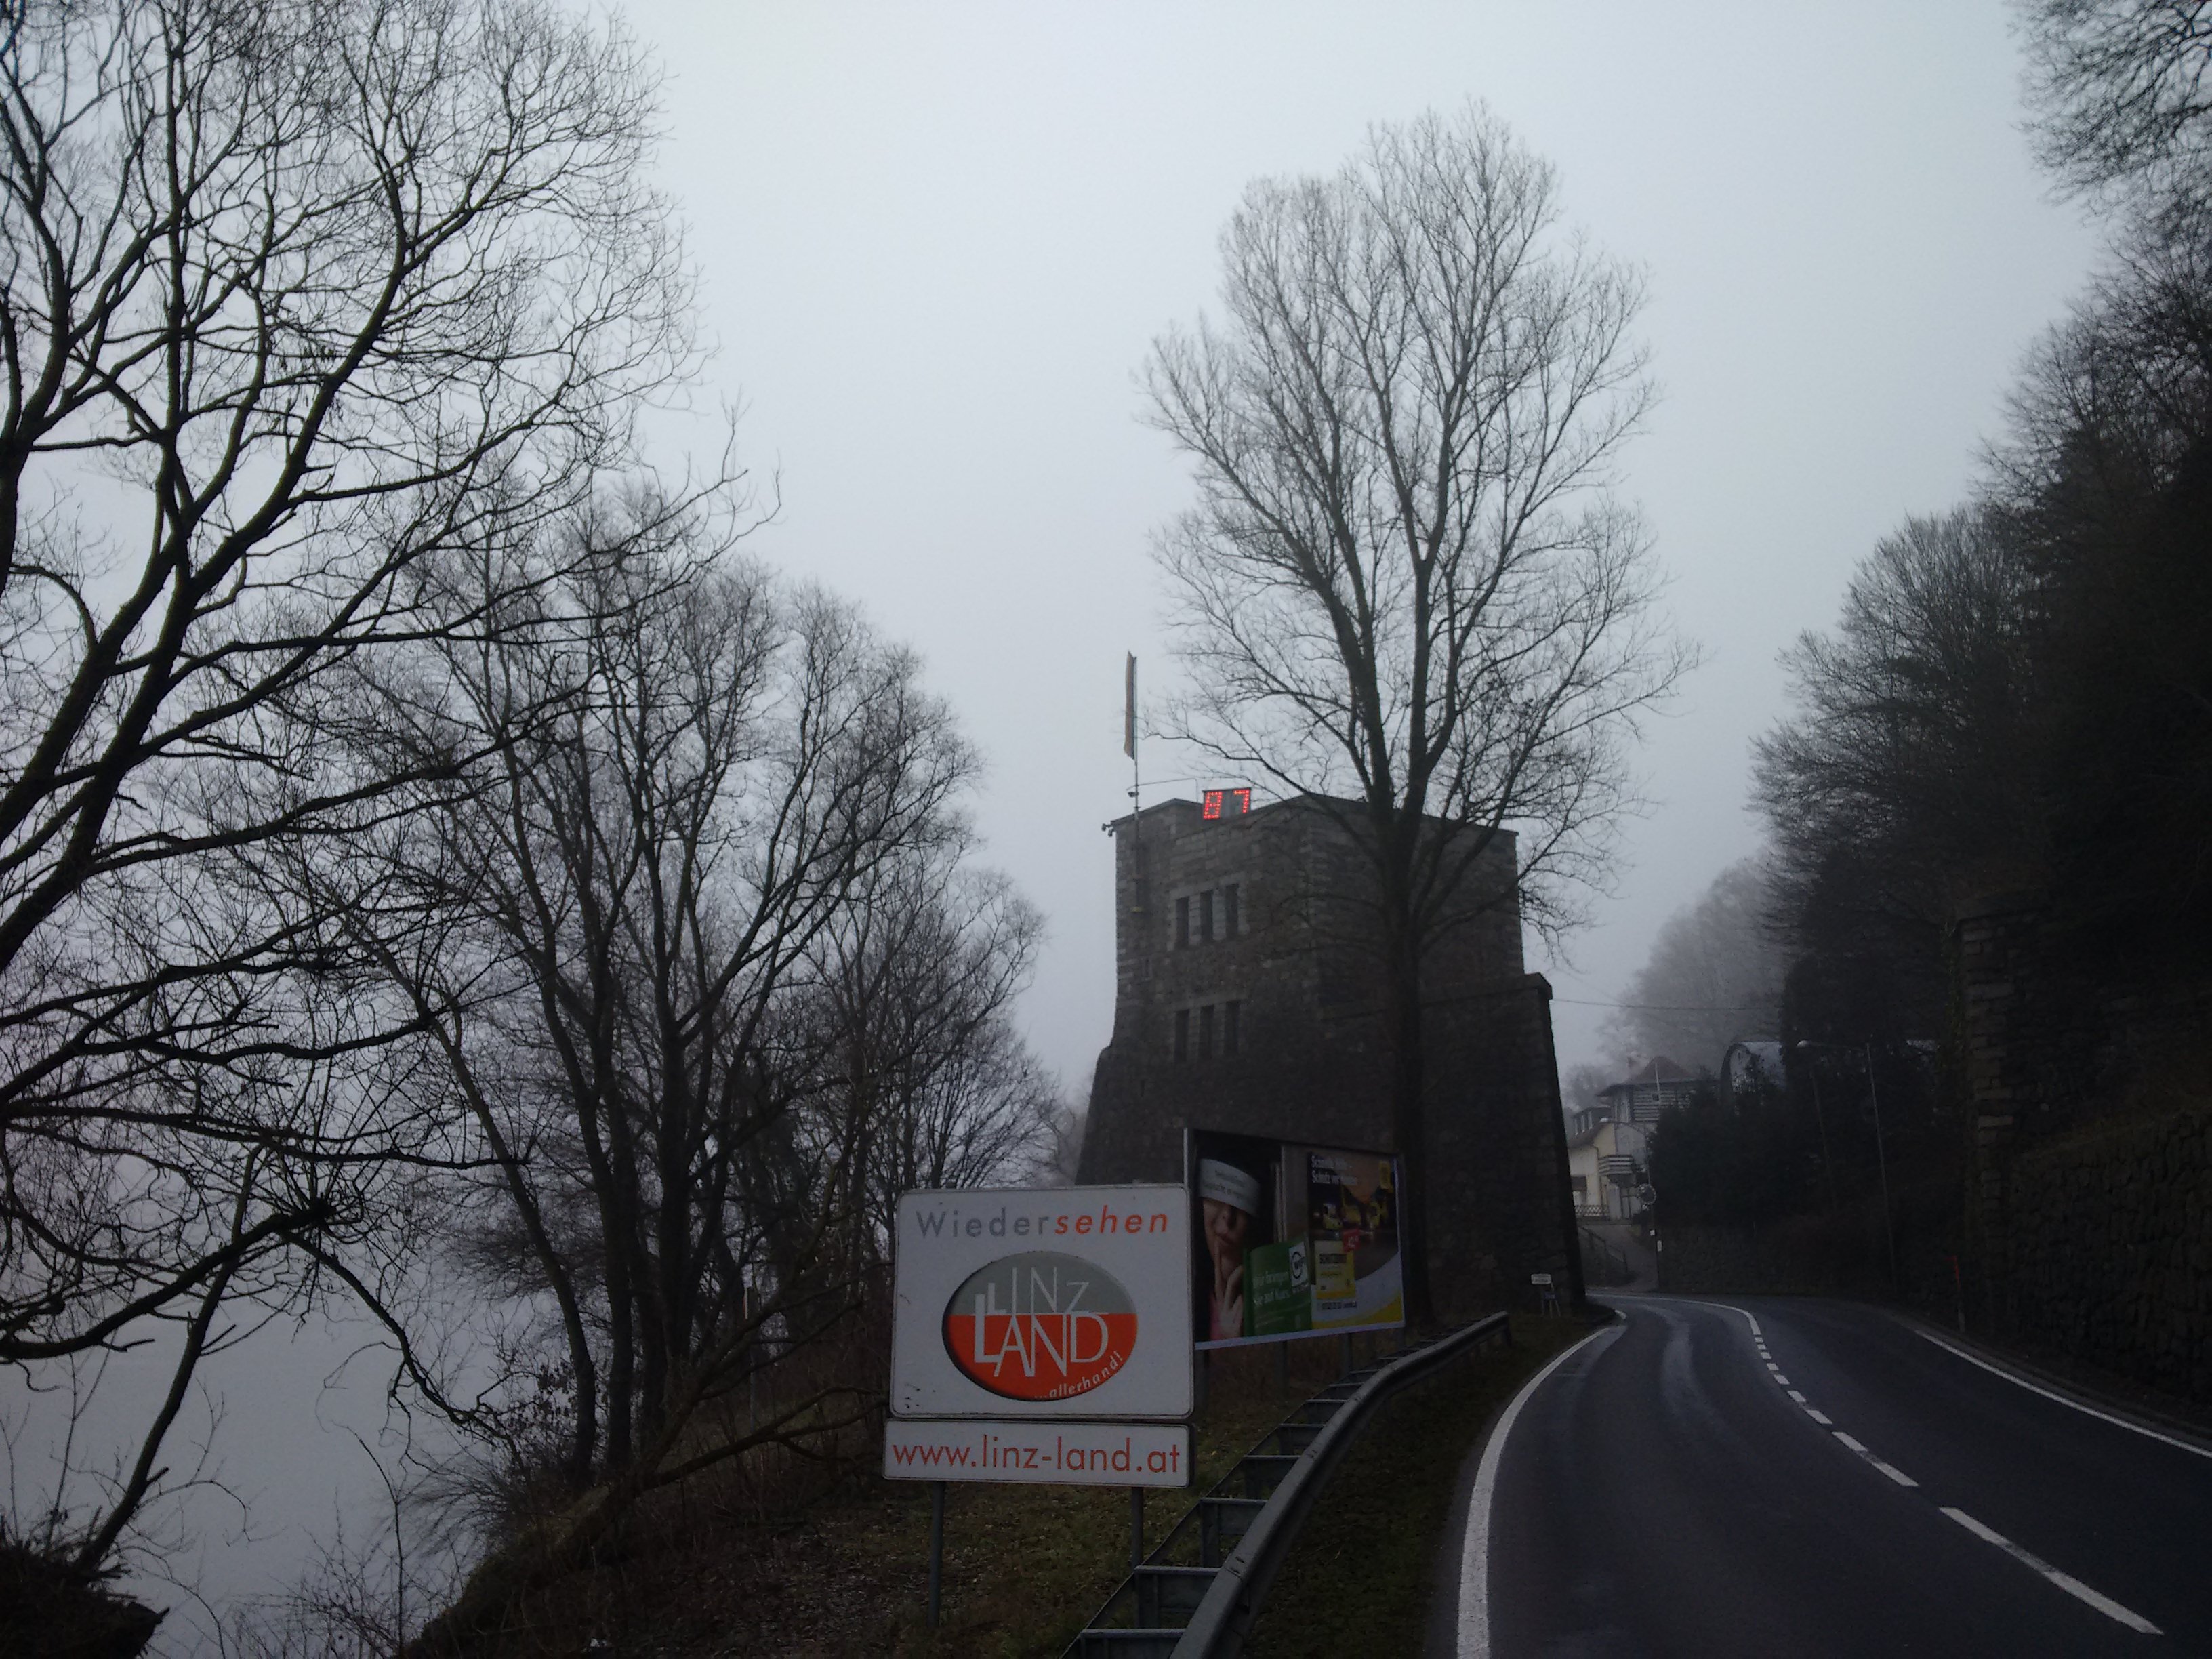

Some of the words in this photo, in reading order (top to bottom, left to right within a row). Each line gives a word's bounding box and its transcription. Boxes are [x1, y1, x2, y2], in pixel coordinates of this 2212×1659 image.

[1204, 790, 1250, 819] 87
[916, 1205, 1169, 1237] Wiedersehen
[986, 1267, 1099, 1315] LINZ
[974, 1293, 1109, 1378] LAND
[892, 1434, 1181, 1473] www.linz-land.at
